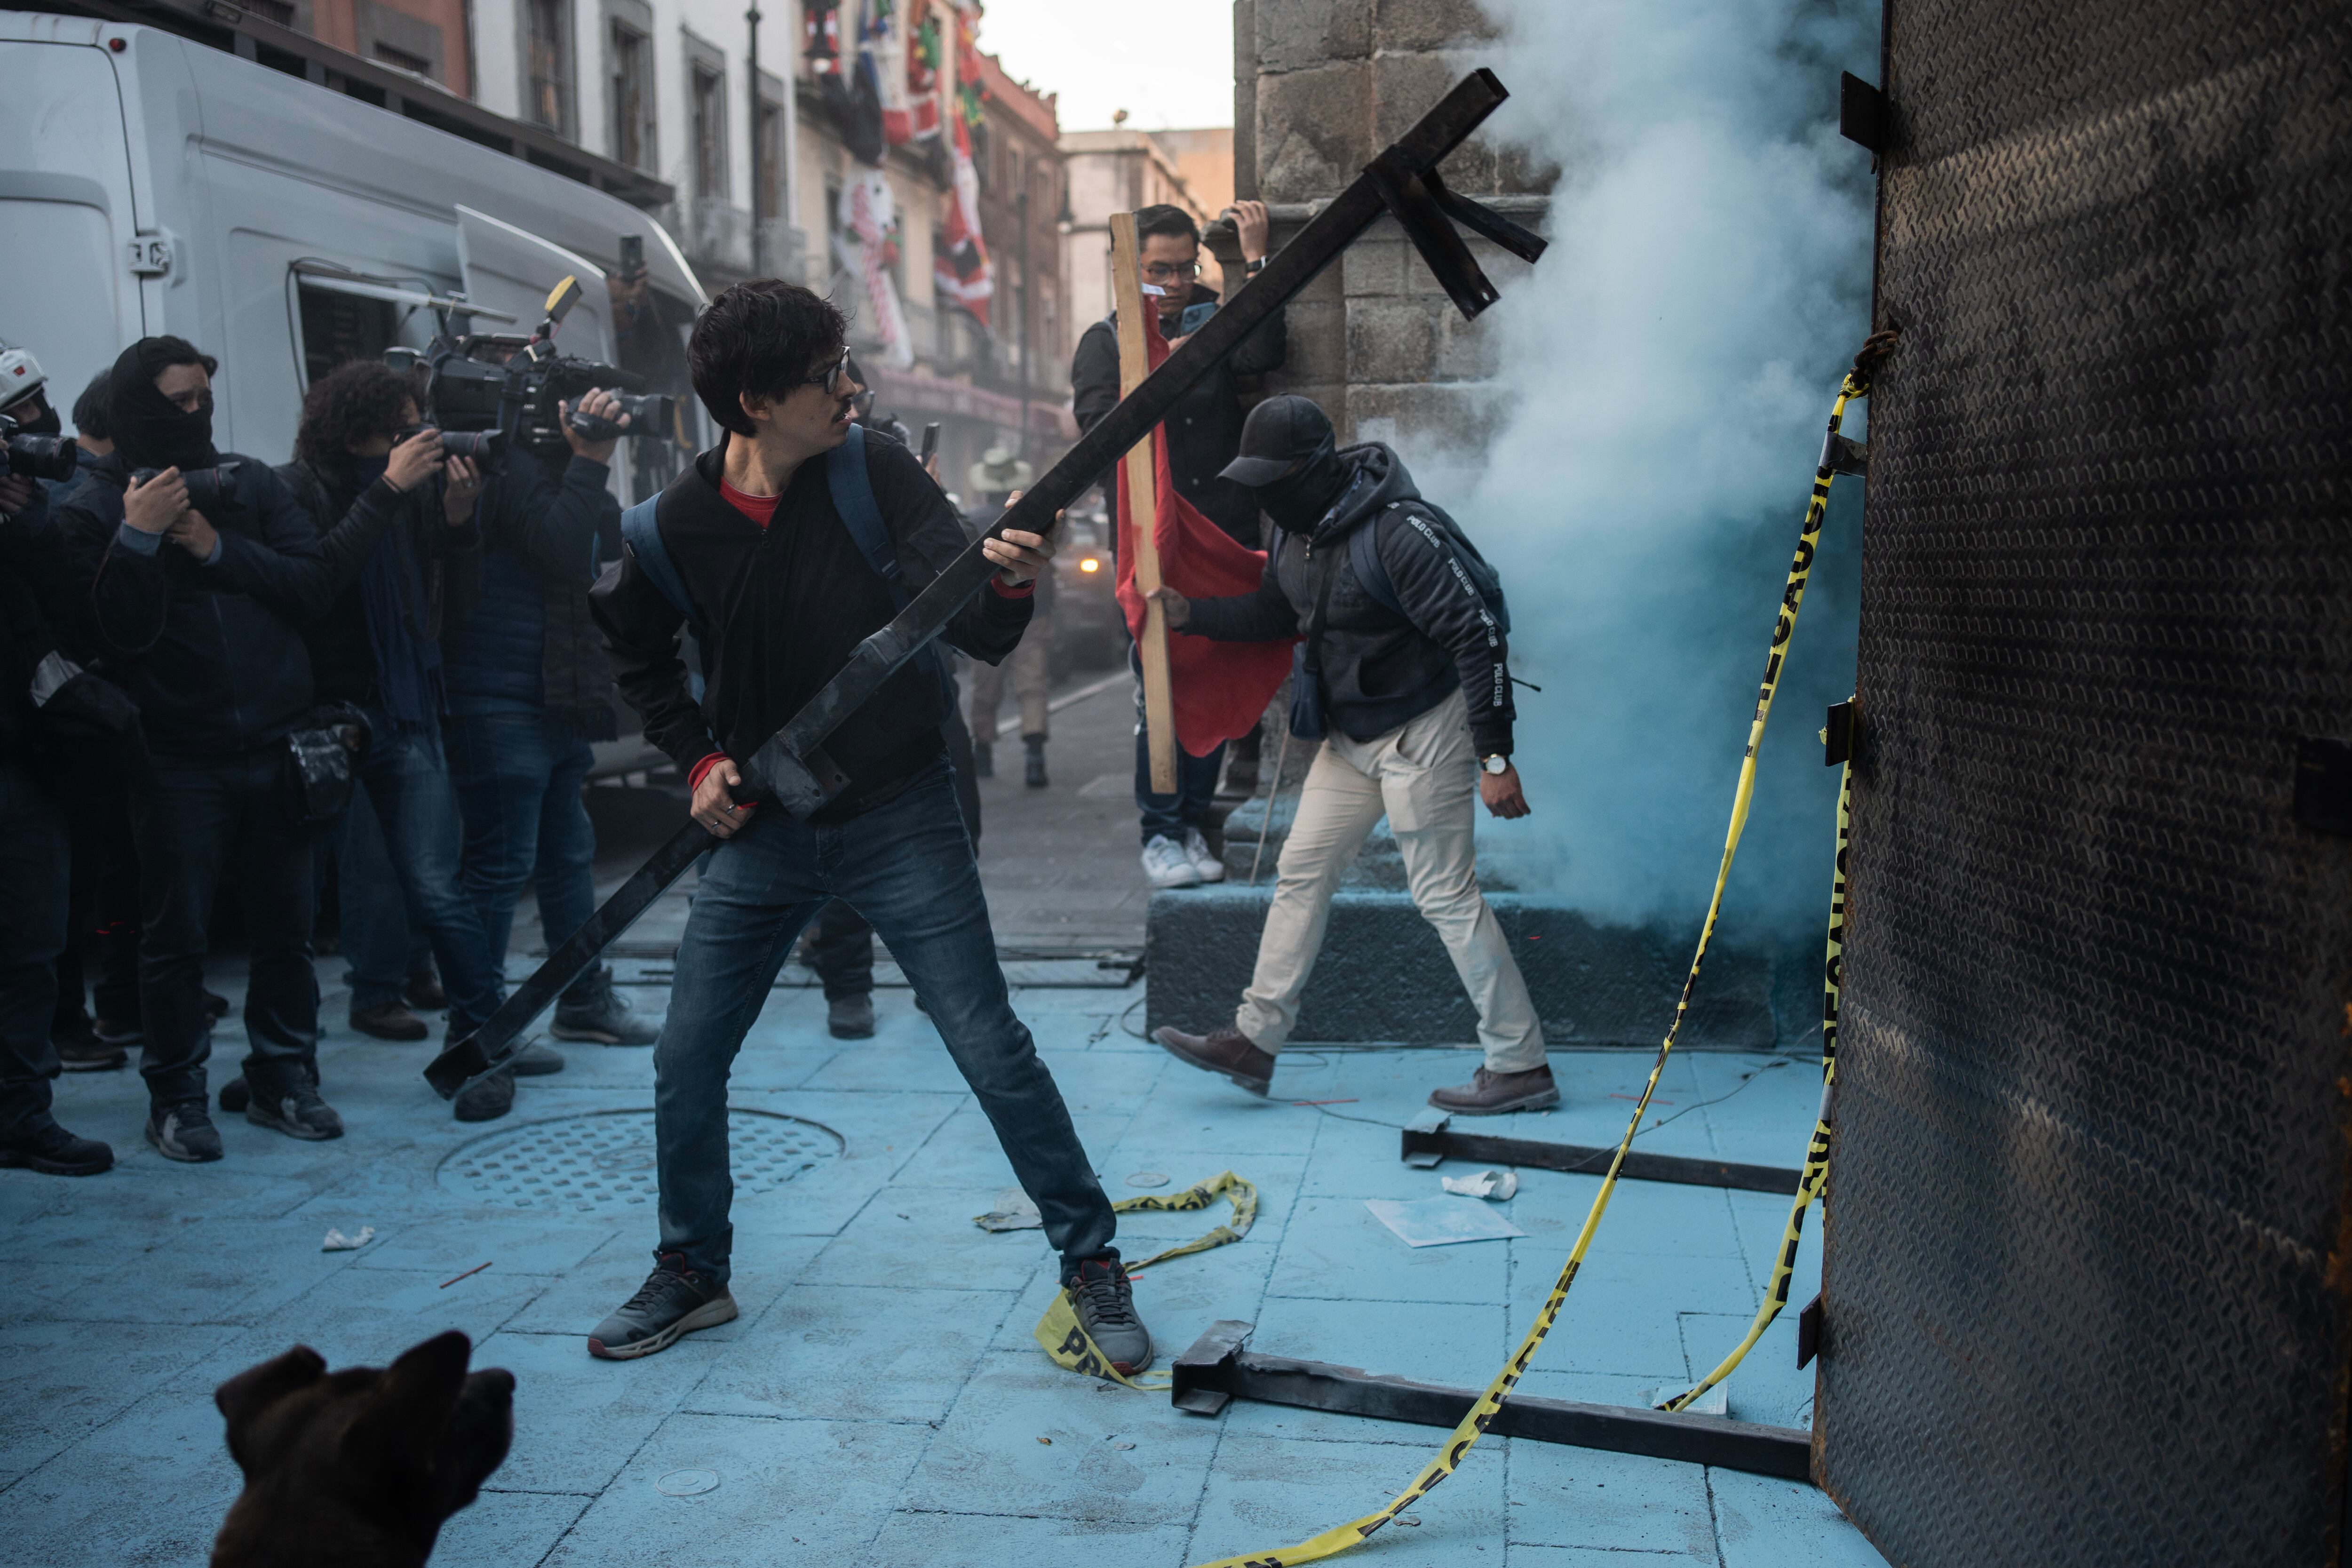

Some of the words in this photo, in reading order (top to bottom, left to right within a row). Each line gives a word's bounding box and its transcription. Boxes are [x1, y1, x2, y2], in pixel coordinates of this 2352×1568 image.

[1406, 515, 1426, 531] POLO
[1423, 528, 1441, 548] CLUB
[1448, 557, 1463, 578] POLO
[1461, 576, 1475, 596] CLUB
[1488, 627, 1498, 647] CLUB
[1494, 662, 1503, 684] POLO
[1493, 685, 1503, 707] CLUB
